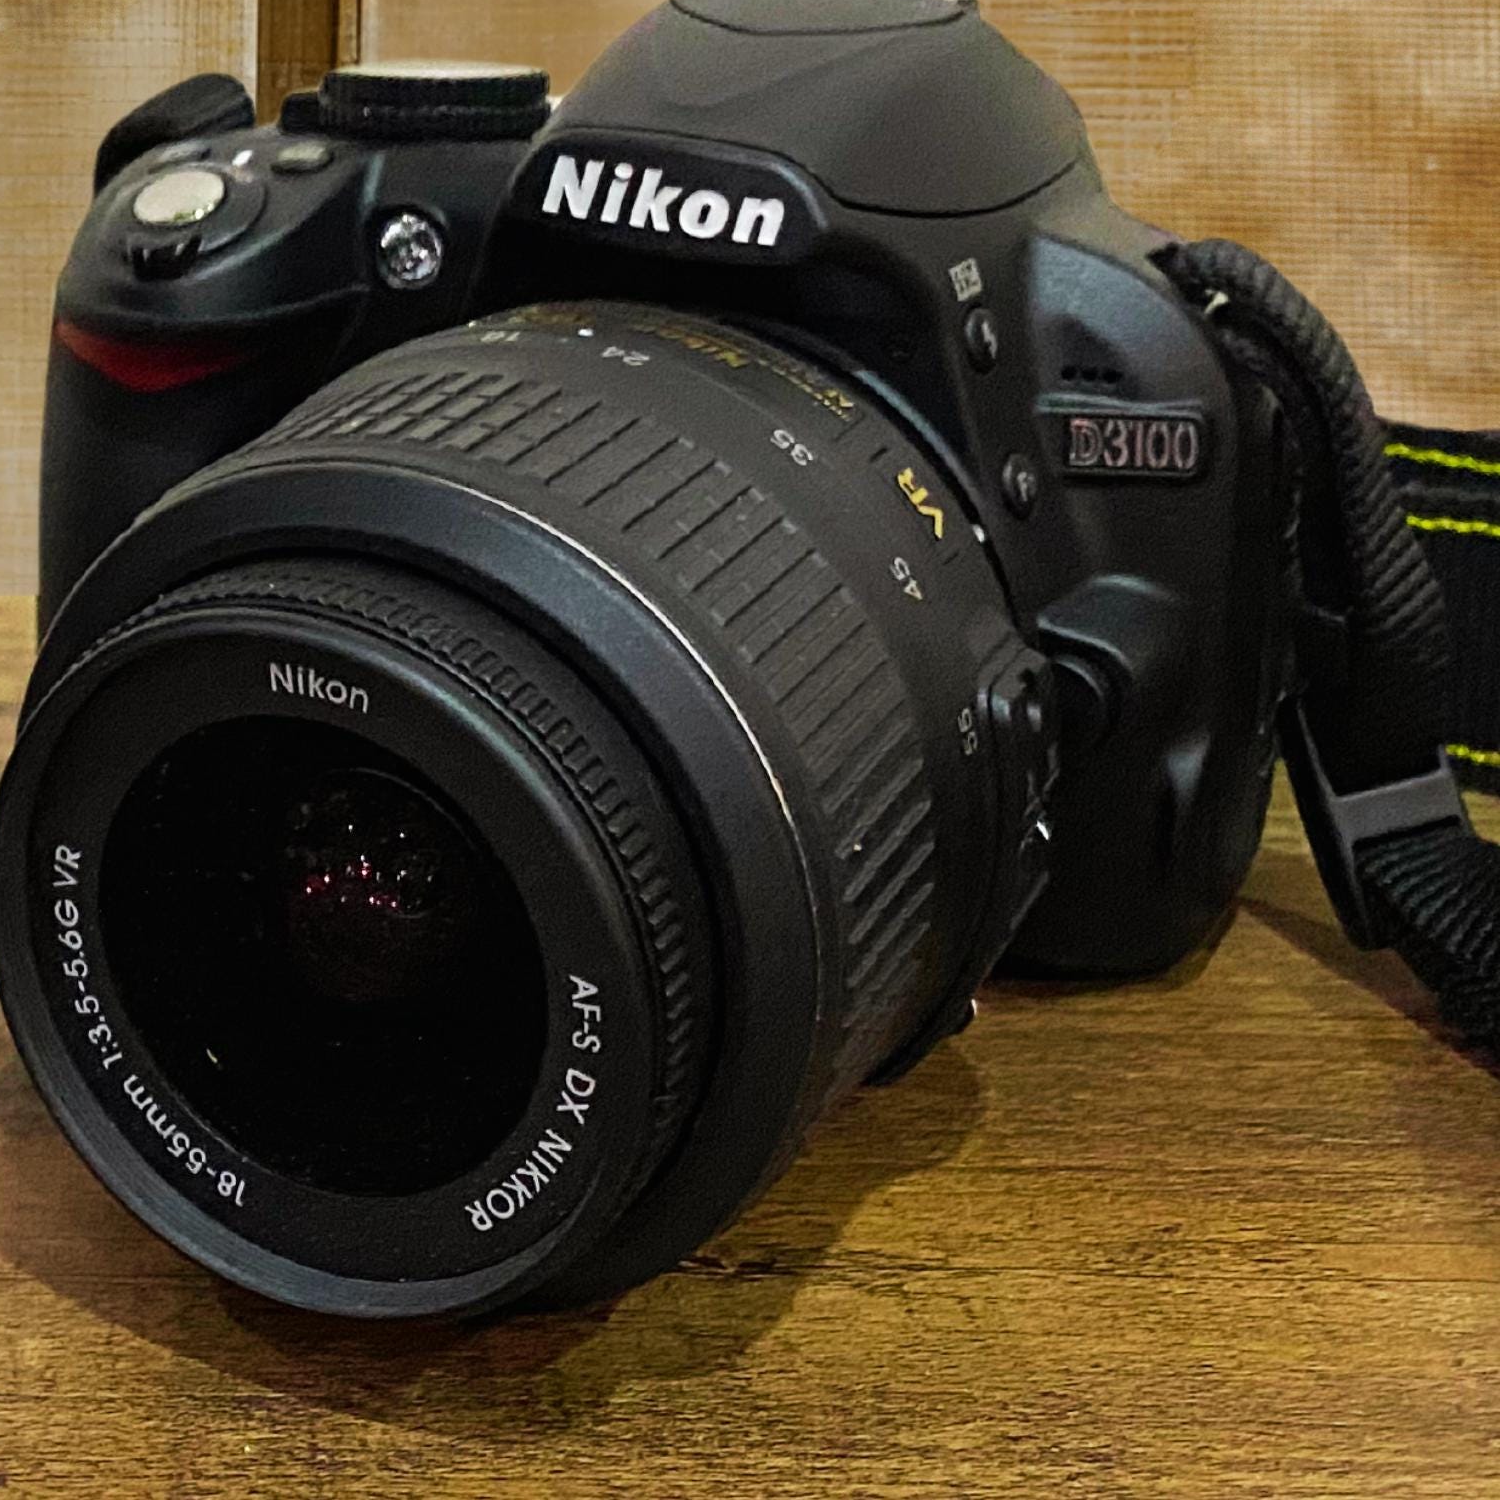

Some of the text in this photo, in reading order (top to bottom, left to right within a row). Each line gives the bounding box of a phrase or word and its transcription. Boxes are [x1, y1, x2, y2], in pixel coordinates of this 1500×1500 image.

[541, 154, 786, 247] Nikon
[769, 428, 814, 467] 35
[1068, 417, 1199, 470] D3100
[896, 467, 944, 540] VR
[890, 556, 923, 601] 45
[268, 662, 371, 714] Nikon
[956, 706, 978, 757] 55
[52, 844, 602, 1233] AF-S DX NIKKOR 18-55mm 1:3.5-5.6G VR
